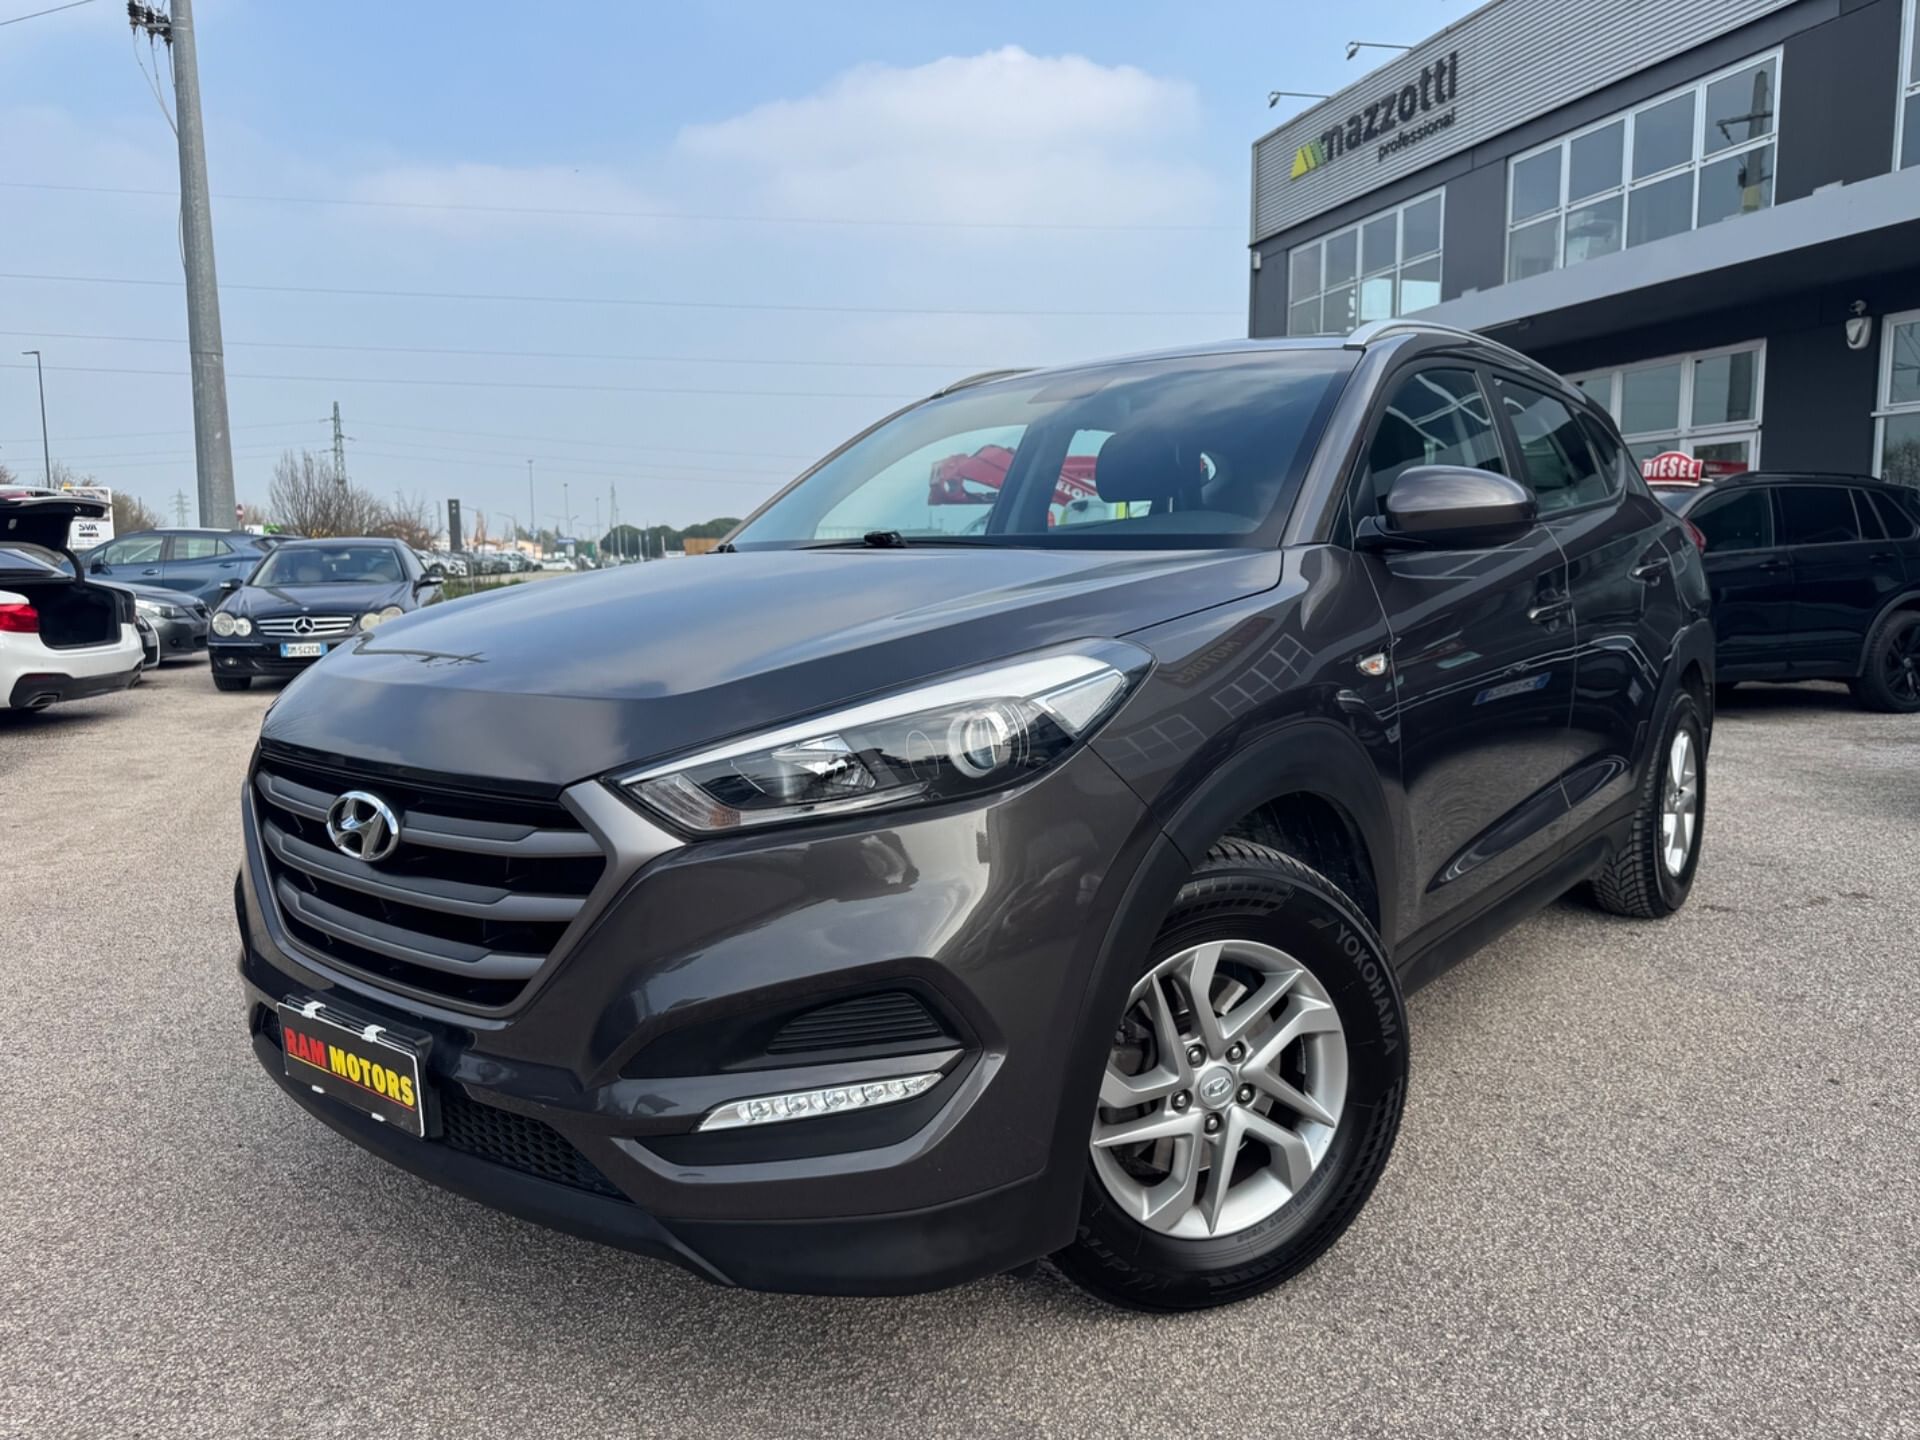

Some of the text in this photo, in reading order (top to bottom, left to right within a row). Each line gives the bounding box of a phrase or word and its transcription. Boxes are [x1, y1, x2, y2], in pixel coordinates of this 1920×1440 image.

[1378, 107, 1456, 162] professional
[1643, 456, 1698, 478] DIESEL
[1336, 923, 1399, 1056] YOKOHAMA
[284, 1027, 415, 1106] RAM MOTORS
